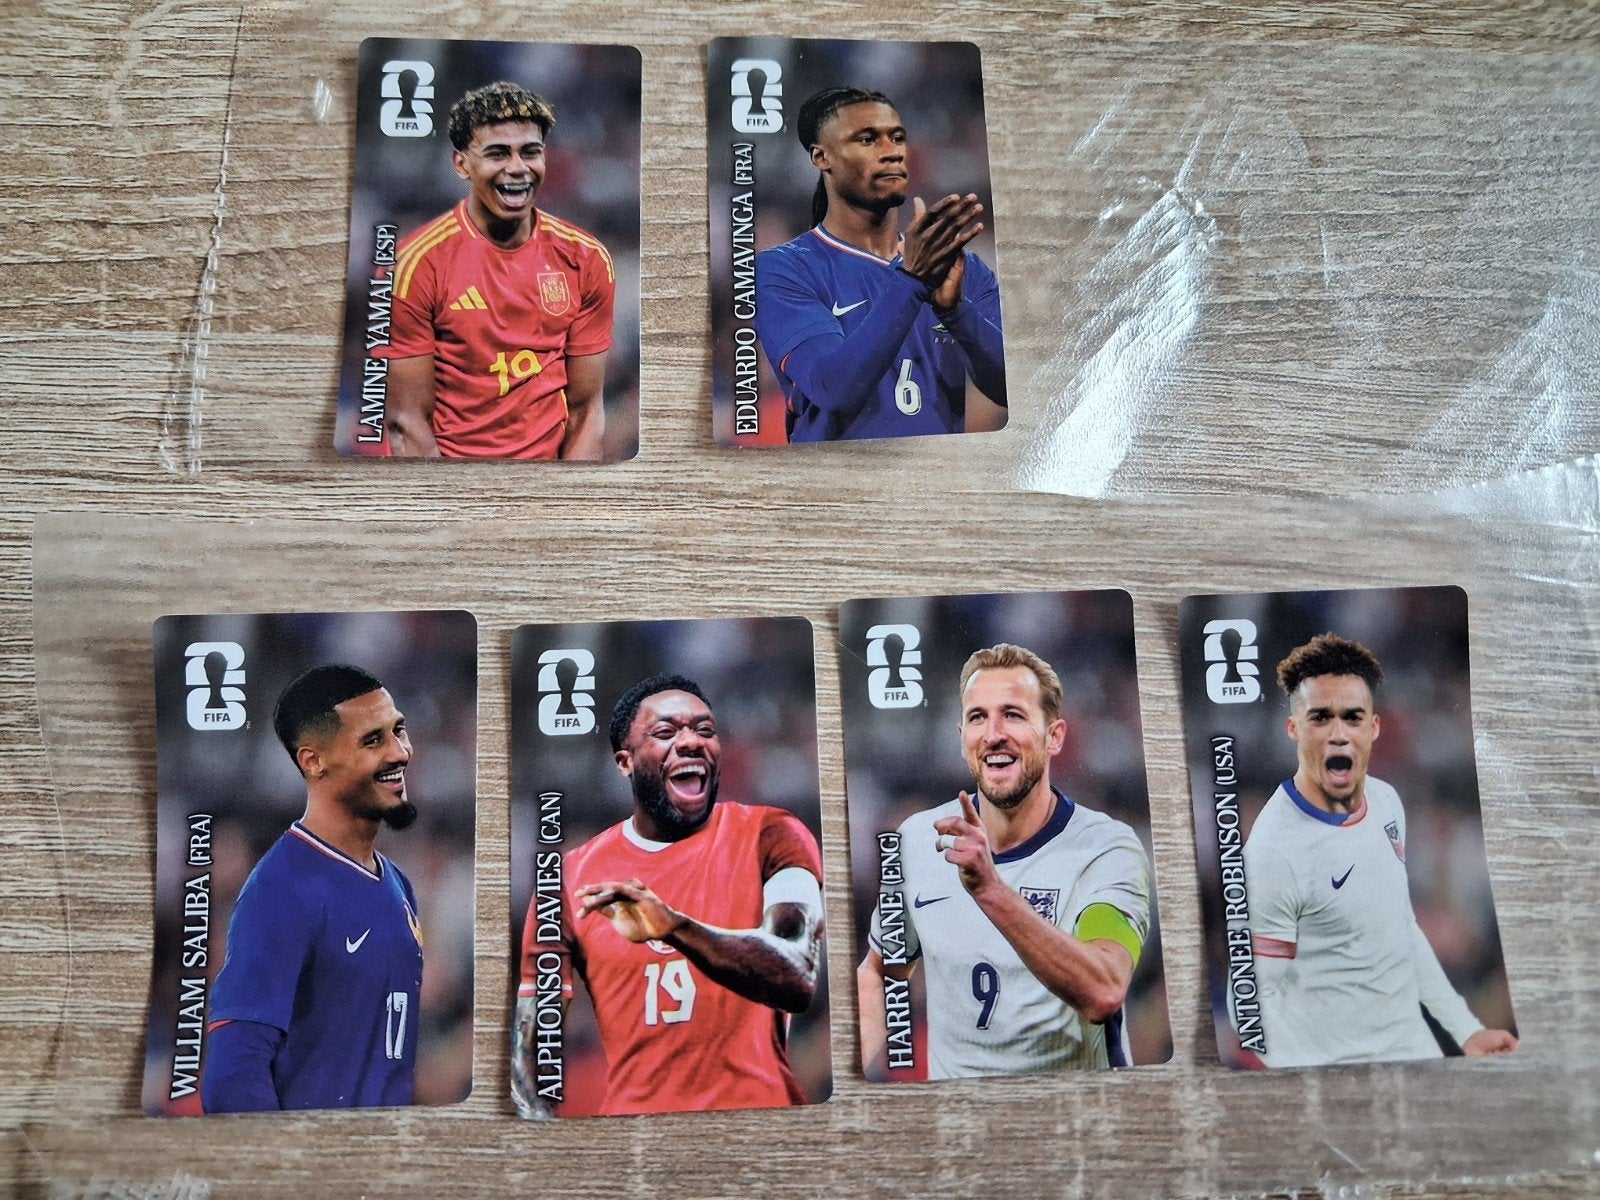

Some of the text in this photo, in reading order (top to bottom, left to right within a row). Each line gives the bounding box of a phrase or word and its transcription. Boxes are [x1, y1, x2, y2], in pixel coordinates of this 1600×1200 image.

[394, 122, 420, 131] FIFA
[746, 118, 770, 127] FIFA
[732, 143, 758, 434] EDUARDO CAMAVINGA (FRA)
[358, 224, 398, 442] LAMINE YAMAL (ESP)
[895, 358, 921, 415] 6
[204, 712, 231, 722] FIFA
[554, 718, 581, 728] FIFA
[884, 691, 910, 701] FIFA
[1221, 686, 1247, 696] FIFA
[1211, 736, 1266, 1054] ANTONEE ROBINSON (USA)
[170, 814, 213, 1099] WILLIAM SALIBA (FRA)
[536, 792, 563, 1101] ALPHONSO DAVIES (CAN)
[877, 832, 914, 1068] HARRY KANE (ENG)
[644, 959, 697, 1025] 19
[972, 962, 1001, 1030] 9
[385, 992, 408, 1059] 17
